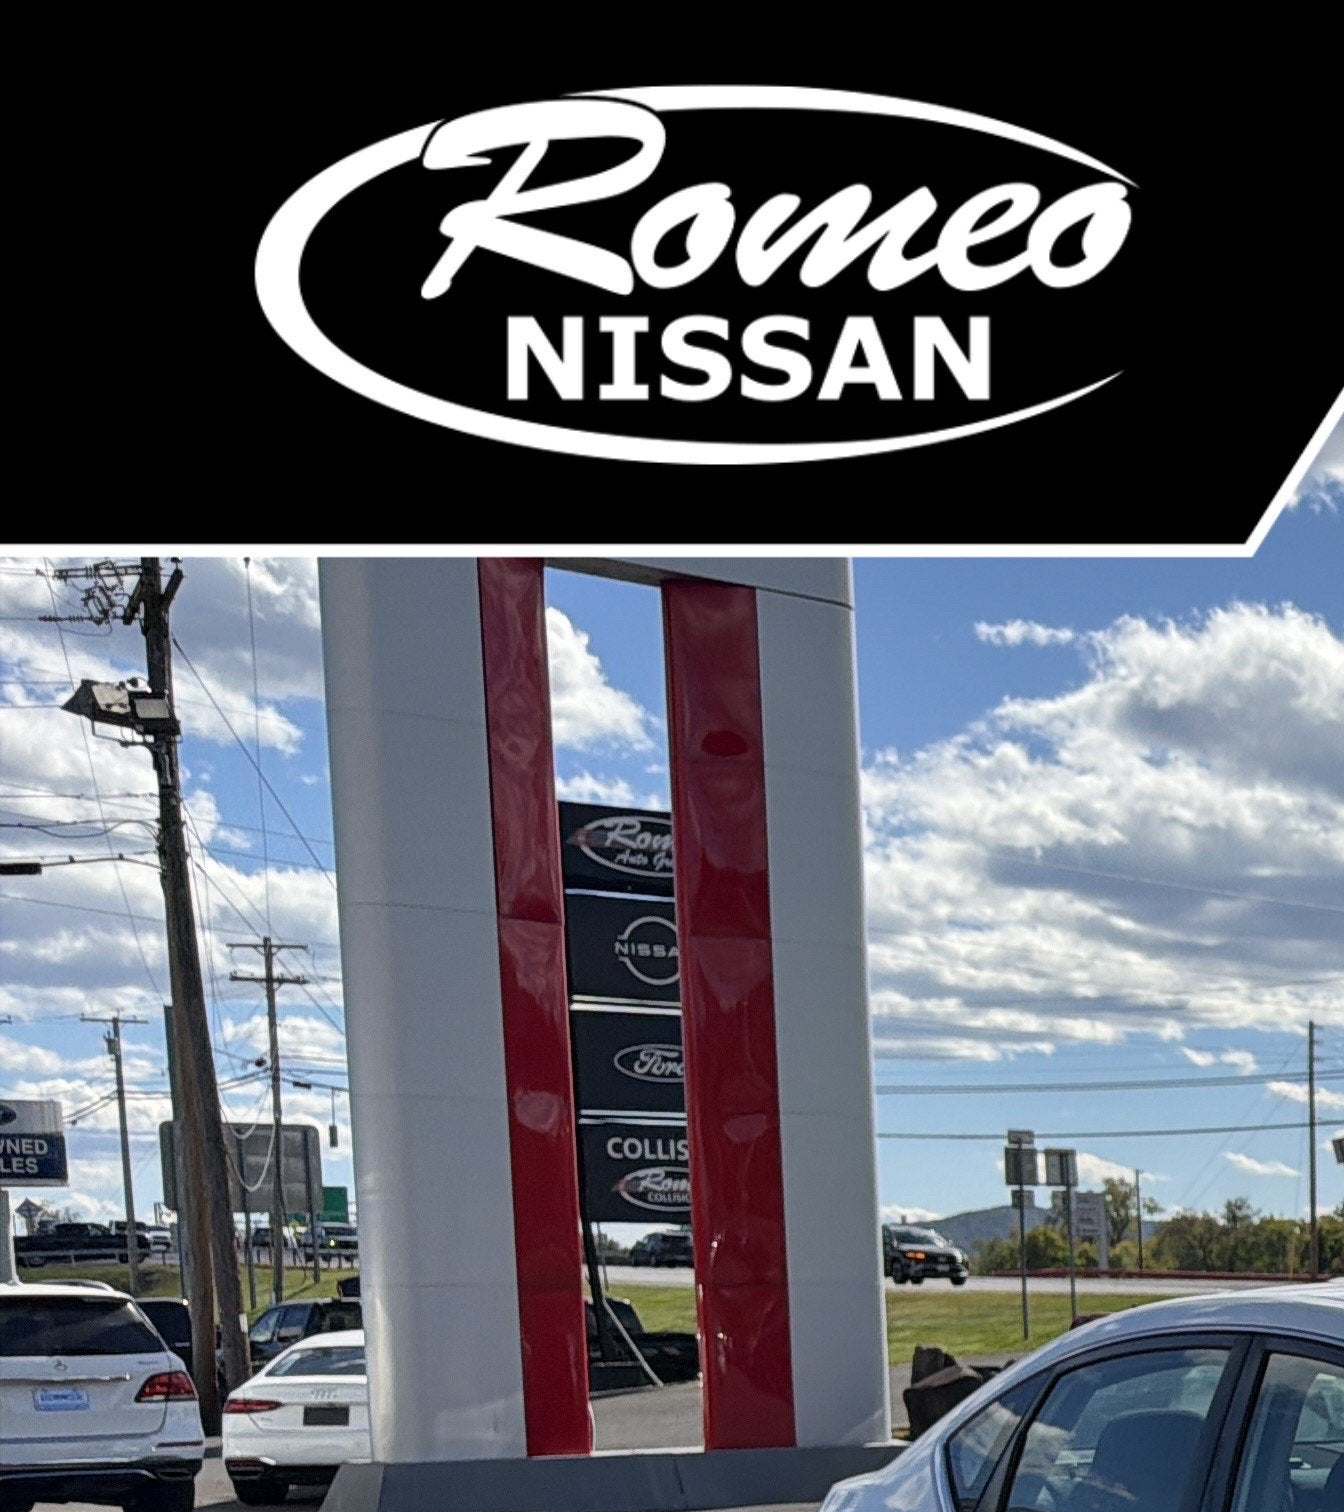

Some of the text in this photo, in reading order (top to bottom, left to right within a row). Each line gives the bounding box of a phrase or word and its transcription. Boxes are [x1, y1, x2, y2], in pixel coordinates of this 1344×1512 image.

[600, 818, 673, 850] Rom
[614, 942, 679, 958] NISSA
[0, 1139, 48, 1155] NED
[606, 1137, 689, 1160] COLLIS
[0, 1157, 39, 1174] LES
[638, 1168, 690, 1192] Rom
